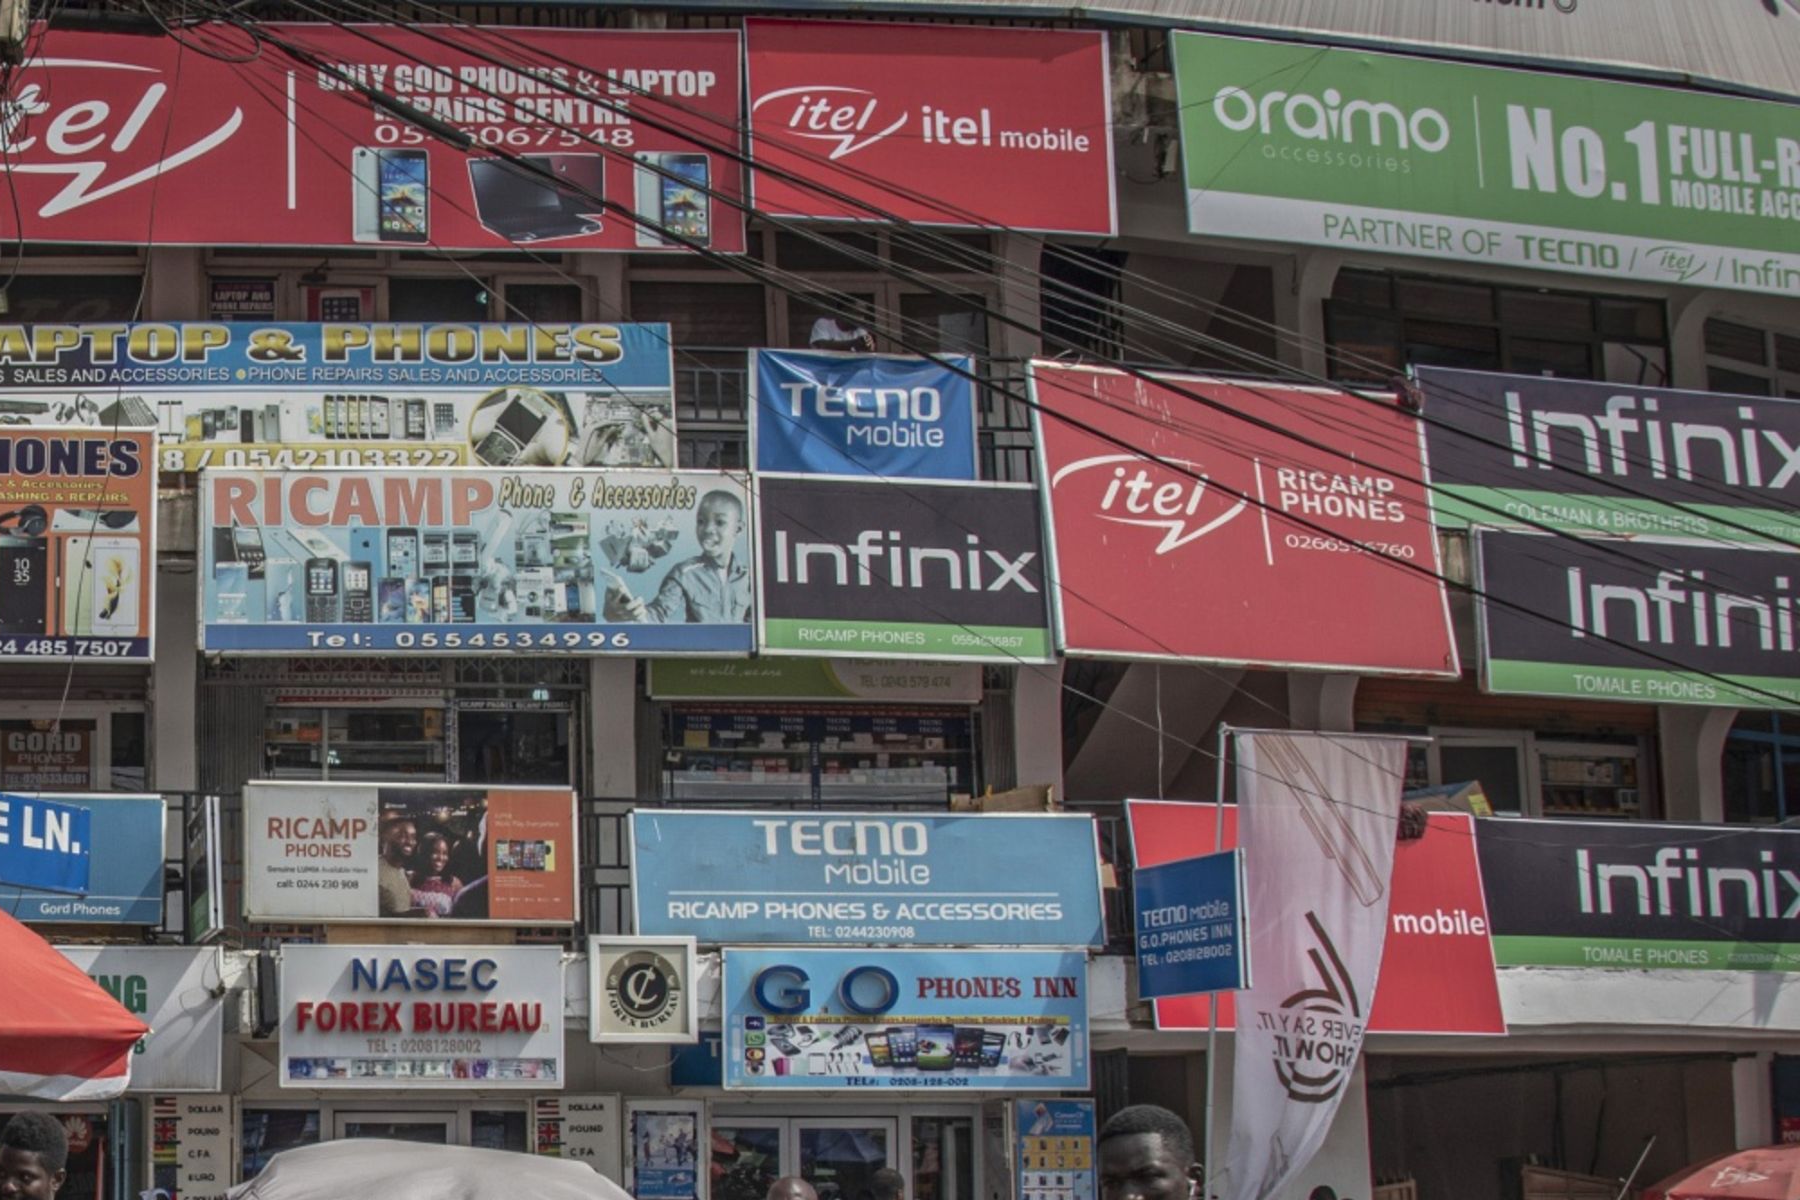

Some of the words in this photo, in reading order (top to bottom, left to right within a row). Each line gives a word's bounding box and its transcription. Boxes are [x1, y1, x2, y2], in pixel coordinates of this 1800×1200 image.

[318, 63, 388, 92] ONLY
[394, 65, 453, 94] GOD
[461, 66, 569, 96] PHONES
[576, 70, 601, 96] &
[607, 69, 716, 97] LAPTOP
[514, 97, 631, 125] CENTRE
[788, 95, 878, 132] itel
[1212, 85, 1450, 153] oraimo
[921, 106, 991, 147] itel
[999, 128, 1090, 153] mobile
[1261, 143, 1412, 174] accessories
[1506, 103, 1661, 205] No.1
[1670, 178, 1756, 216] MOBILE
[1323, 213, 1452, 253] PARTNER
[1463, 223, 1502, 256] OF
[1515, 234, 1620, 271] TECNO
[246, 327, 306, 364] &
[322, 323, 624, 364] PHONES
[13, 368, 68, 384] SALES
[70, 368, 107, 384] AND
[108, 367, 230, 384] ACCESSORIES
[248, 366, 307, 382] PHONE
[311, 367, 384, 382] REPAIRS
[387, 368, 441, 383] SALES
[443, 368, 479, 383] AND
[482, 368, 604, 384] ACCESSORIES
[779, 381, 941, 423] TECNO
[1101, 466, 1209, 517] itel
[1278, 468, 1395, 499] RICAMP
[69, 492, 129, 502] REPAIRS
[212, 475, 496, 527] RICAMP
[500, 477, 557, 509] Phone
[570, 477, 586, 505] &
[591, 476, 697, 511] Accessories
[1281, 490, 1406, 523] PHONES
[1503, 502, 1593, 527] COLEMAN
[774, 529, 1039, 593] Infinix
[24, 639, 68, 655] 485
[73, 639, 133, 656] 7507
[307, 630, 373, 648] Tel:
[394, 630, 631, 649] 0554534996
[798, 628, 858, 643] RICAMP
[861, 629, 925, 645] PHONES
[1573, 673, 1642, 694] TOMALE
[1646, 678, 1717, 700] PHONES
[7, 732, 81, 752] GORD
[22, 809, 82, 855] LN.
[267, 816, 368, 840] RICAMP
[752, 819, 929, 856] TECNO
[285, 843, 353, 858] PHONES
[39, 901, 69, 917] Gord
[71, 902, 122, 917] Phones
[667, 901, 759, 921] RICAMP
[764, 901, 866, 922] PHONES
[872, 902, 891, 921] &
[897, 902, 1063, 922] ACCESSORIES
[1141, 904, 1188, 929] TECNO
[834, 925, 915, 938] 0244230908
[1210, 922, 1233, 939] INN
[1393, 907, 1486, 938] mobile
[1582, 946, 1644, 963] TOMALE
[1647, 948, 1709, 965] PHONES
[351, 957, 499, 992] NASEC
[915, 976, 1022, 1000] PHONES
[1032, 975, 1078, 998] INN
[295, 1001, 404, 1034] FOREX
[412, 1002, 544, 1034] BUREAU
[400, 1038, 482, 1054] 0208128002
[187, 1104, 224, 1114] DOLLAR
[568, 1103, 605, 1112] DOLLAR
[187, 1127, 221, 1137] POUND
[569, 1124, 603, 1134] POUND
[187, 1172, 215, 1182] EURO
